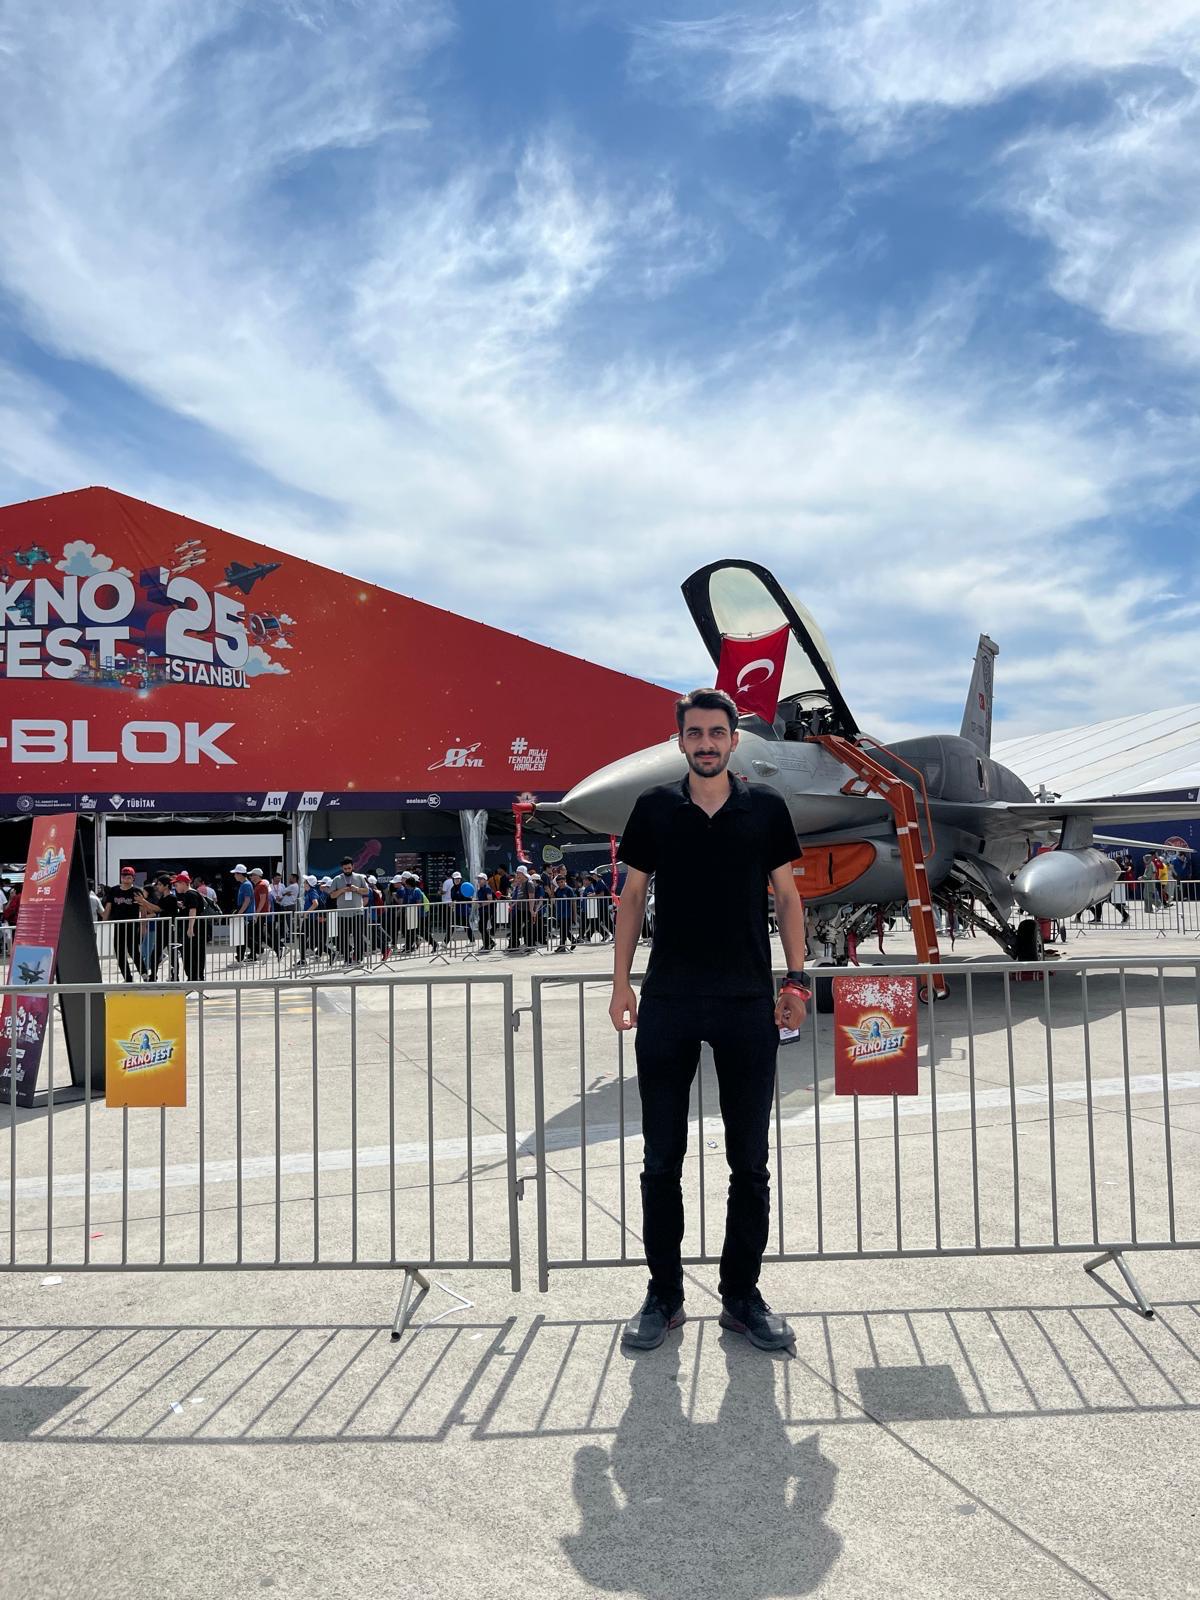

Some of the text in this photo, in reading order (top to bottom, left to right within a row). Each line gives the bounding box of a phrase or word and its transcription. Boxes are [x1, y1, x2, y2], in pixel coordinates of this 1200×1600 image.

[0, 627, 130, 679] EST
[165, 658, 250, 688] İSTANBUL
[127, 799, 155, 807] TÜBİTAK
[850, 1033, 905, 1057] TEKNOFEST
[122, 1047, 174, 1069] TEKNOFEST
